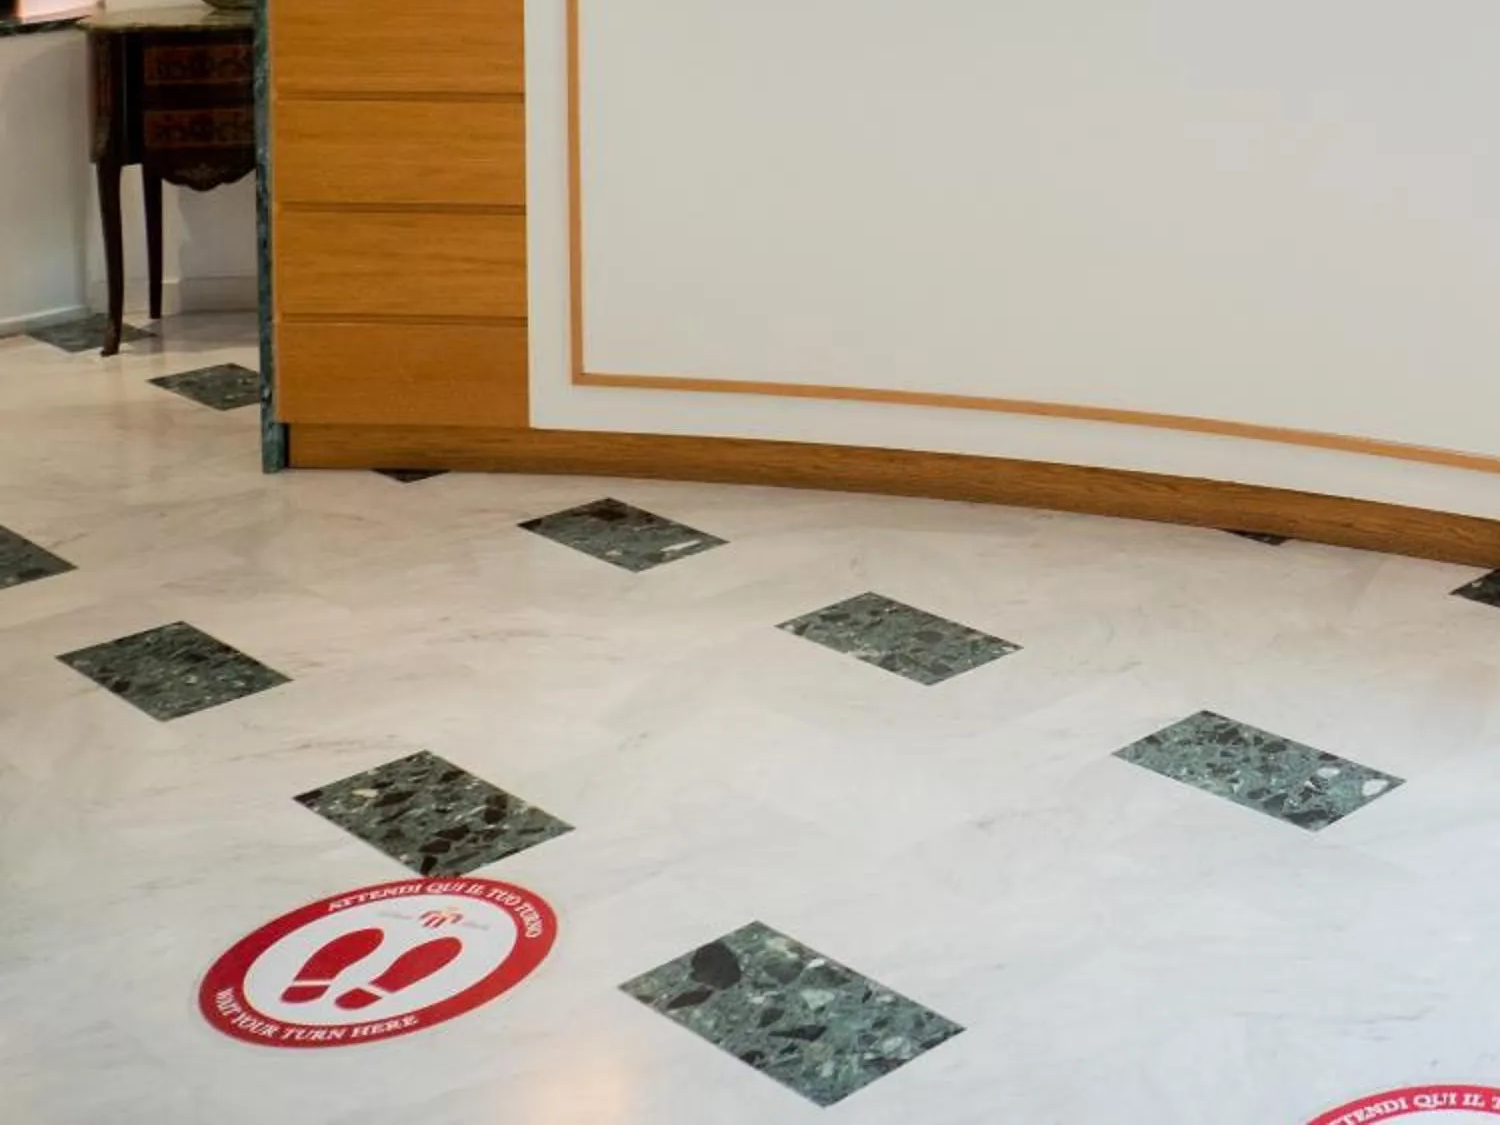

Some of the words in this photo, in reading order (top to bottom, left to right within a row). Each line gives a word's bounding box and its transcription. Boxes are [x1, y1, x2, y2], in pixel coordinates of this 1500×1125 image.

[328, 884, 422, 911] ATTENDI
[425, 881, 469, 893] QUI
[464, 884, 486, 895] IL
[485, 888, 523, 906] TUO
[513, 901, 544, 938] TURNO
[215, 987, 242, 1017] WAIT
[231, 1013, 281, 1037] YOUR
[281, 1027, 347, 1040] TURN
[350, 1015, 418, 1038] HERE
[1413, 1093, 1457, 1107] QUI
[1462, 1093, 1485, 1107] IL
